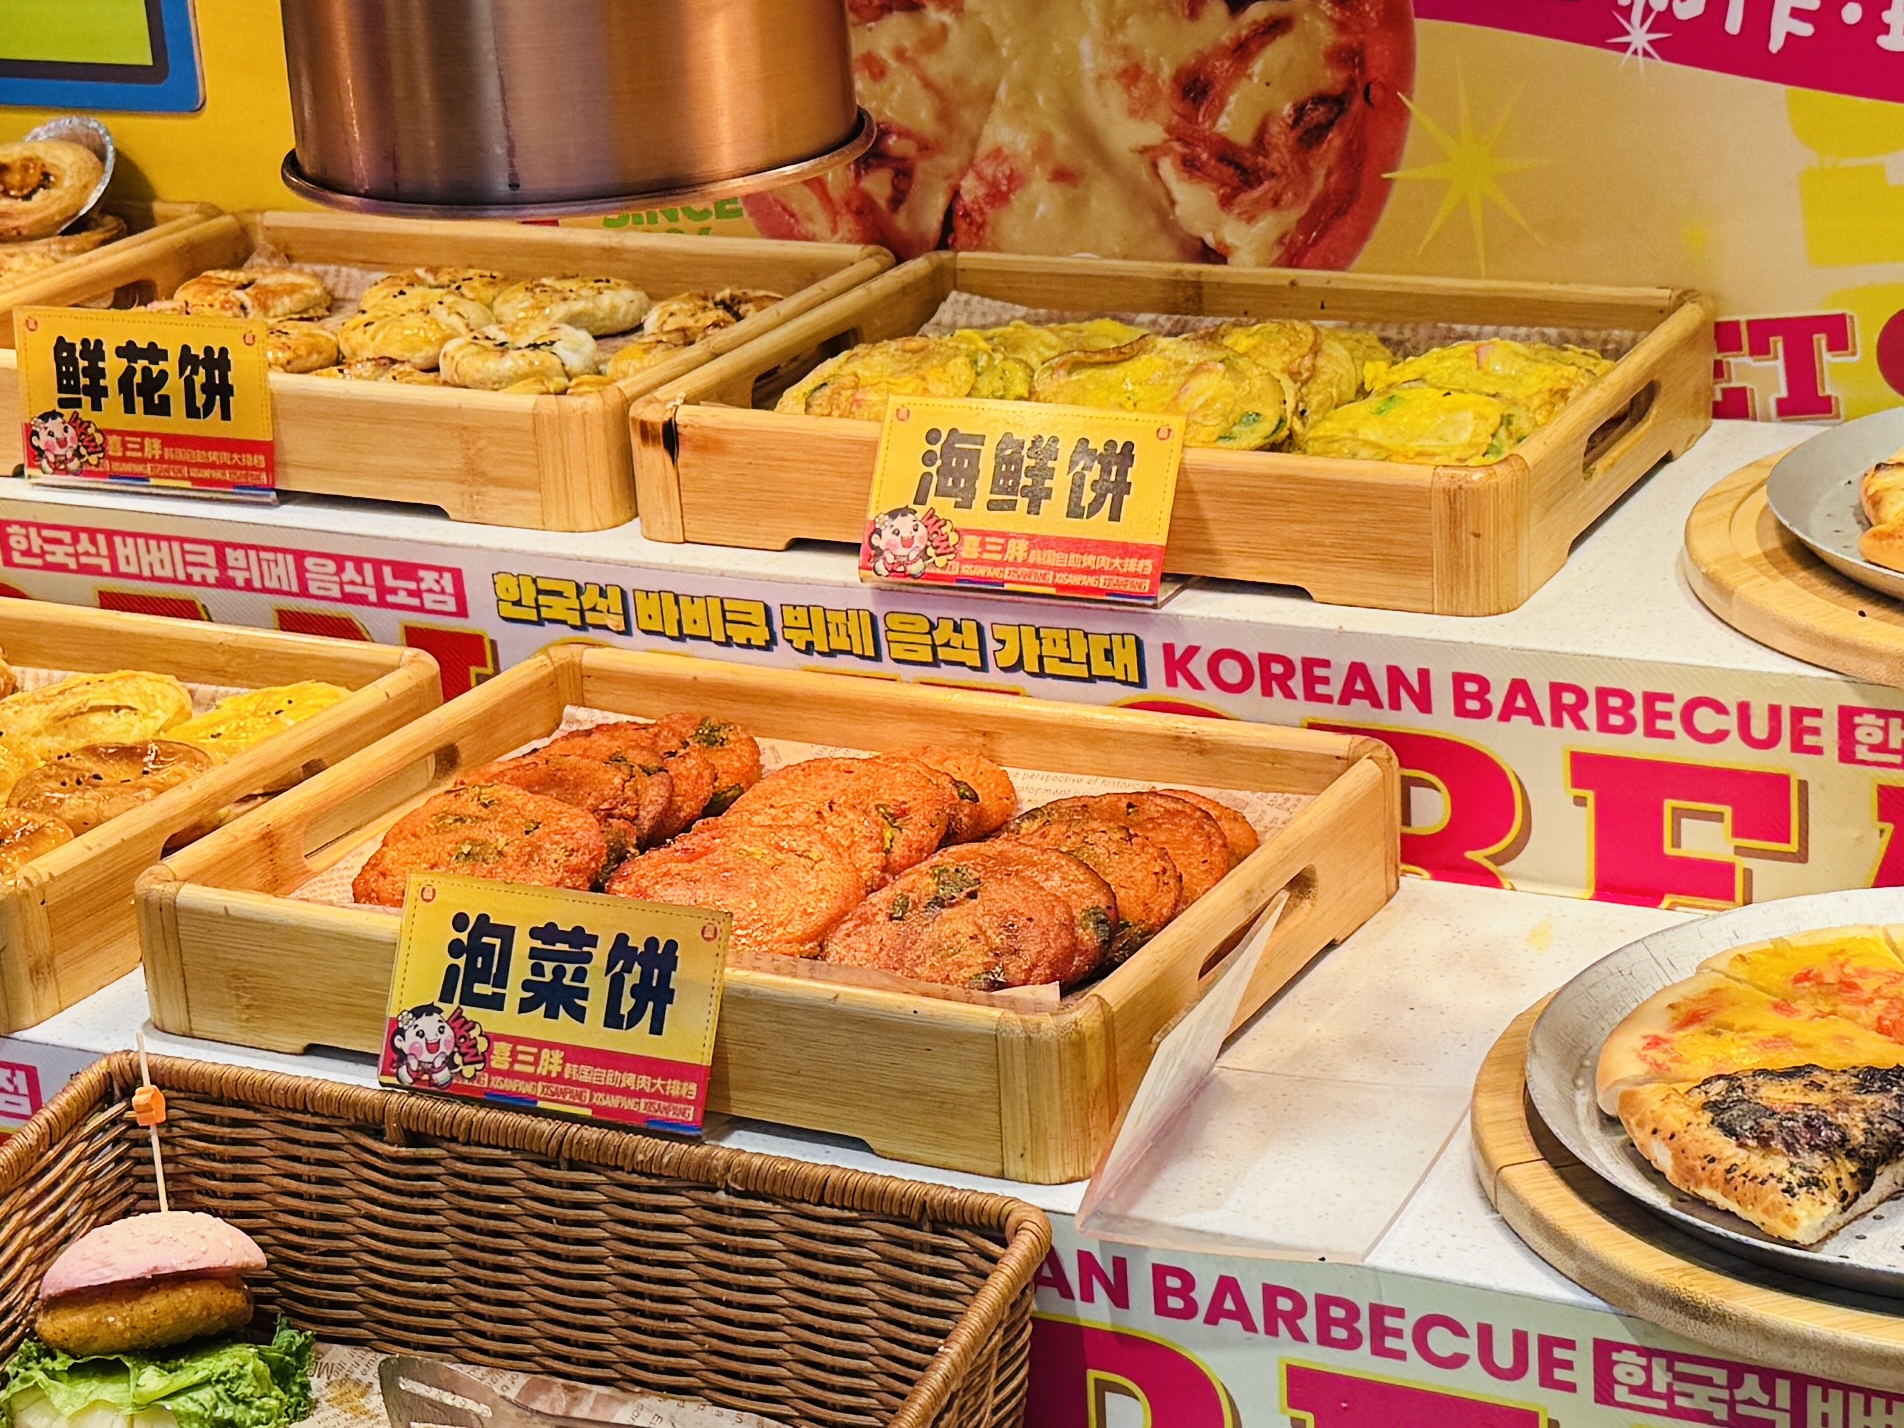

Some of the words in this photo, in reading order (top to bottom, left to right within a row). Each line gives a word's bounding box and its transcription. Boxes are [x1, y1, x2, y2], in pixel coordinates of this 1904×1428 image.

[53, 335, 235, 422] 鲜花饼
[912, 427, 1136, 524] 海鲜饼
[6, 522, 112, 574] 한국식
[115, 533, 223, 586] 바비큐
[225, 545, 298, 594] 뷔페
[303, 556, 376, 604] 음식
[383, 566, 456, 614] 노점
[960, 535, 1030, 564] 喜三胖
[492, 571, 629, 638] 한국식
[636, 587, 778, 652] 바비큐
[781, 601, 880, 661] 뷔페
[884, 612, 987, 673] 음식
[992, 624, 1147, 689] 가판대
[1162, 642, 1434, 717] KOREAN
[1451, 671, 1825, 756] BARBECUE
[438, 911, 679, 1037] 泡菜饼
[490, 1040, 565, 1075] 喜三胖
[1151, 1261, 1578, 1395] BARBECUE
